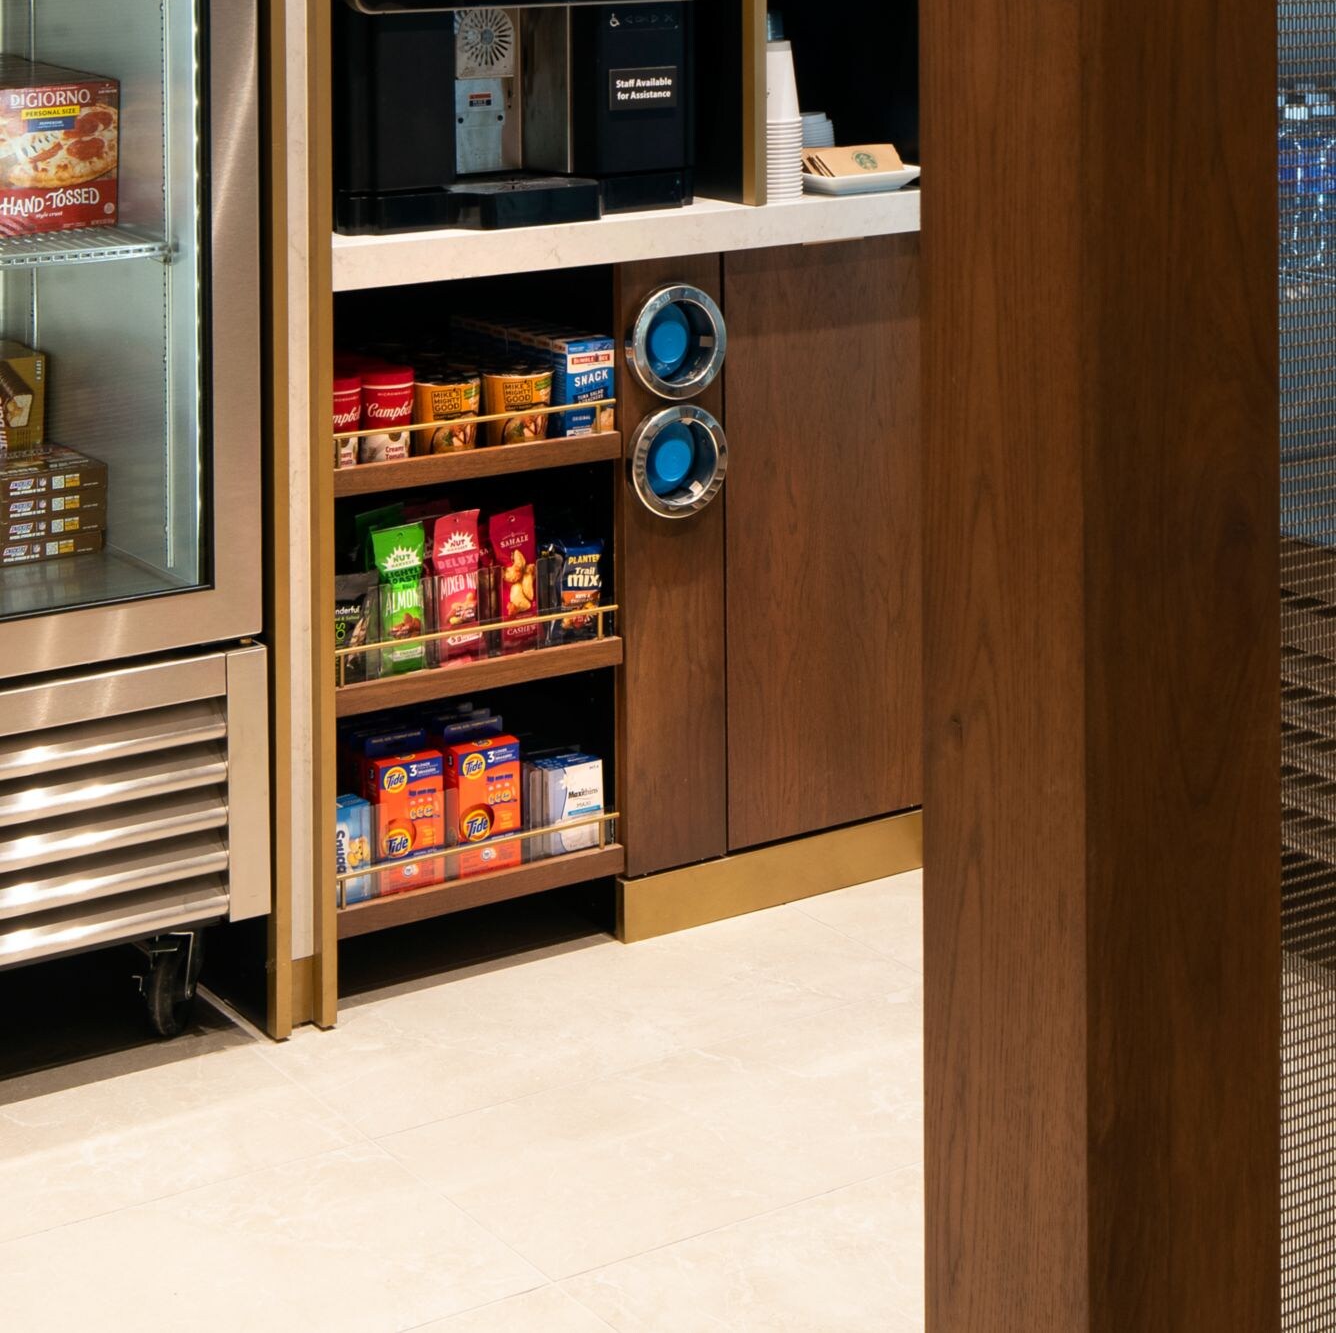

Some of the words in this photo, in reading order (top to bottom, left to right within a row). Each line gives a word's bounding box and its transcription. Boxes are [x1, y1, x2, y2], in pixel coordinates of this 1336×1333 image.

[615, 79, 635, 88] Staff
[636, 77, 672, 87] Available
[617, 91, 629, 100] for
[630, 90, 671, 99] Assistance
[25, 109, 61, 118] PERSONAL
[62, 107, 77, 115] SIZE
[574, 369, 609, 388] SNACK
[505, 394, 531, 403] GOOD
[434, 402, 460, 412] GOOD
[575, 566, 596, 575] Trail
[567, 574, 601, 587] mix
[487, 750, 495, 763] 3
[409, 764, 418, 777] 3
[465, 759, 485, 777] Tide
[386, 772, 406, 791] Tide
[465, 816, 489, 839] Tide
[386, 835, 410, 855] Tide
